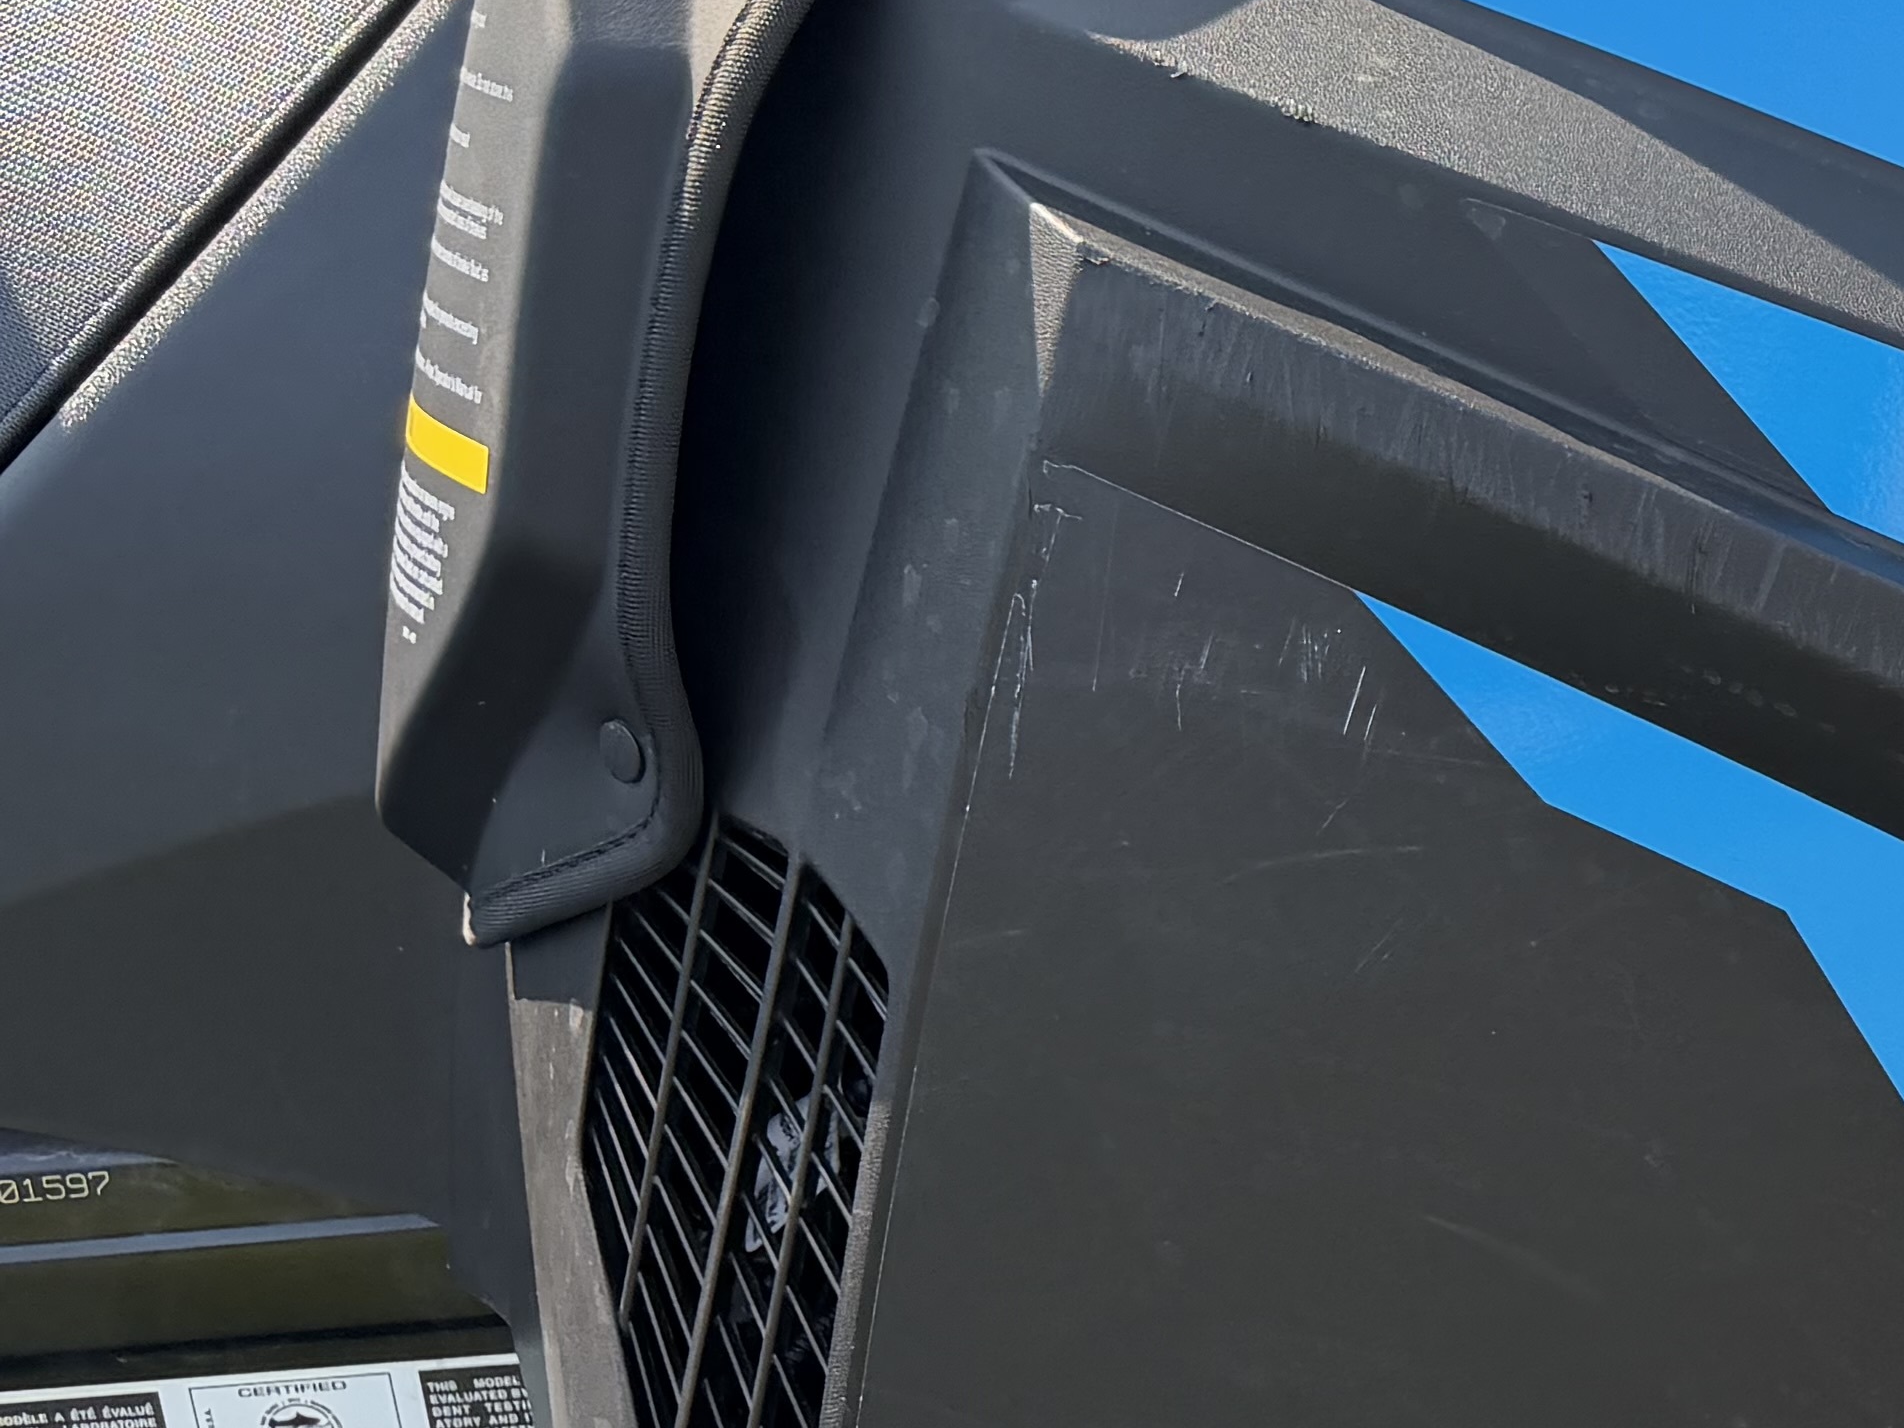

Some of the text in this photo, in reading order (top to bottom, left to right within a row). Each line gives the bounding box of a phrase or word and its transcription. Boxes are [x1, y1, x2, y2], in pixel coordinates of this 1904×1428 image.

[0, 1171, 109, 1204] 01597
[238, 1380, 347, 1398] CERTIFIED
[473, 1375, 521, 1388] MODEL
[429, 1389, 508, 1405] EVALUATED
[54, 1412, 66, 1422] A
[102, 1402, 155, 1419] ÉVALUÉ
[432, 1404, 471, 1418] DENT
[489, 1413, 519, 1426] AND
